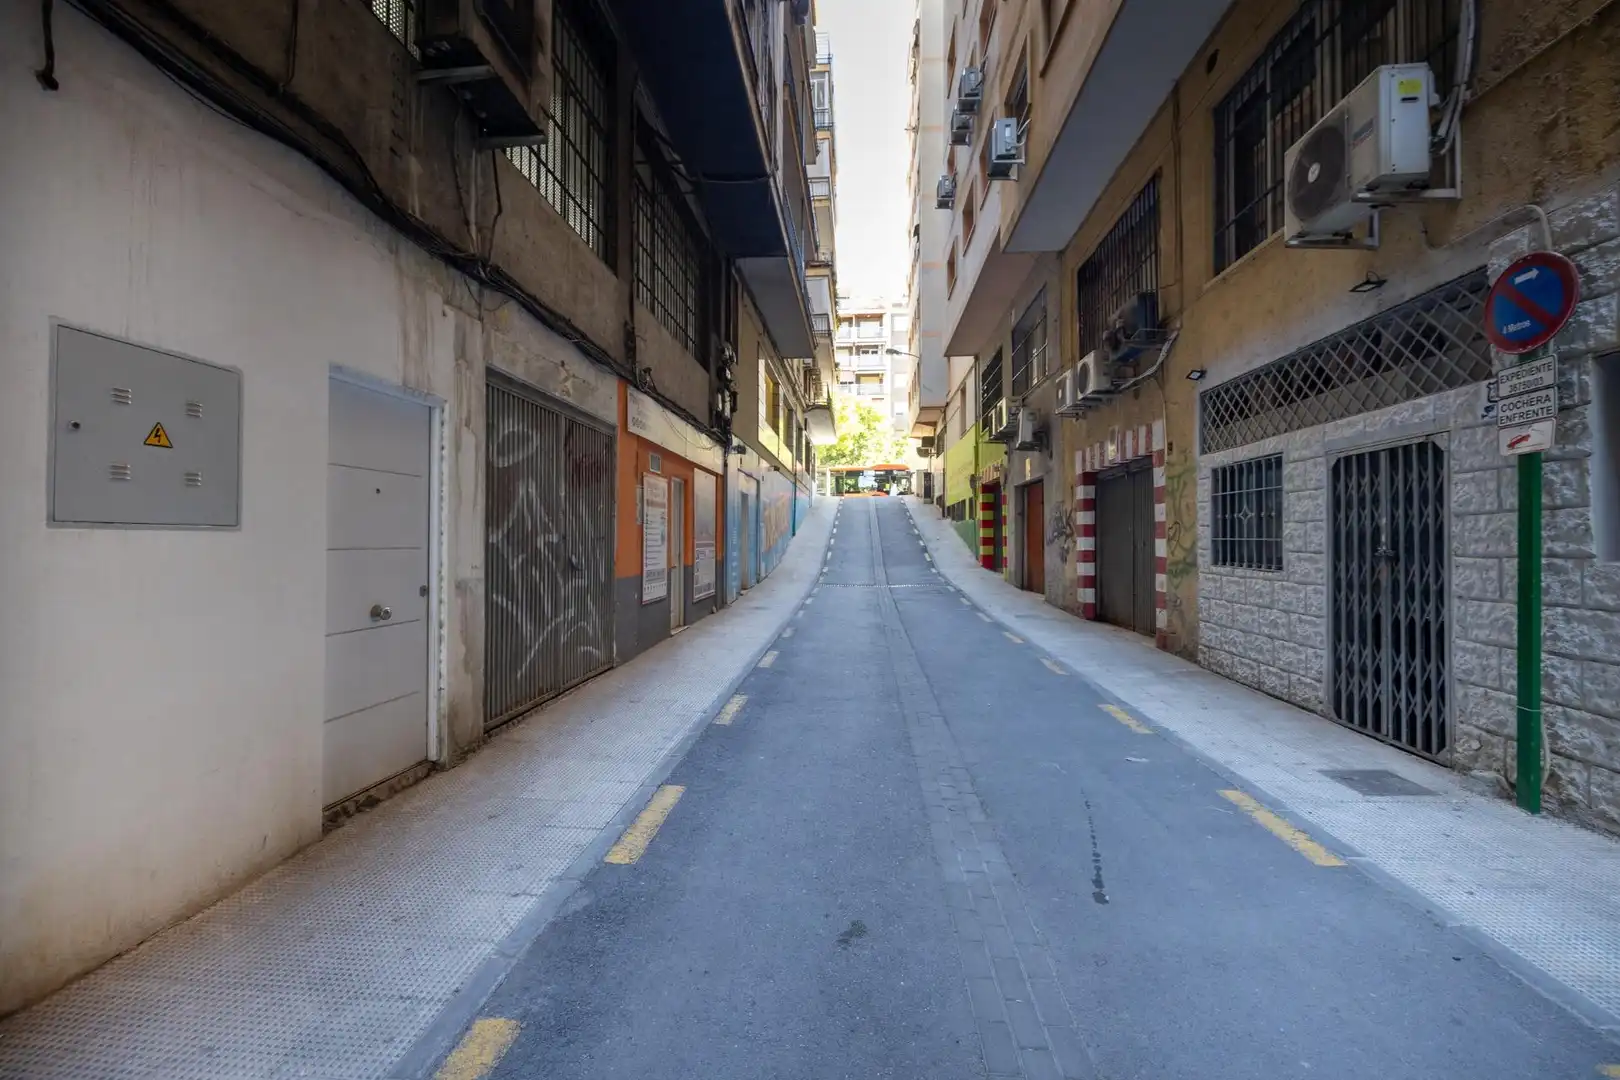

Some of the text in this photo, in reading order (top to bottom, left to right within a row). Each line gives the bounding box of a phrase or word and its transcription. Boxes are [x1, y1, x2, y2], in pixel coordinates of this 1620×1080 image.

[1499, 361, 1553, 384] EXPEDIENTE
[1500, 394, 1551, 413] COCHERA
[1499, 405, 1553, 425] ENFRENTE
